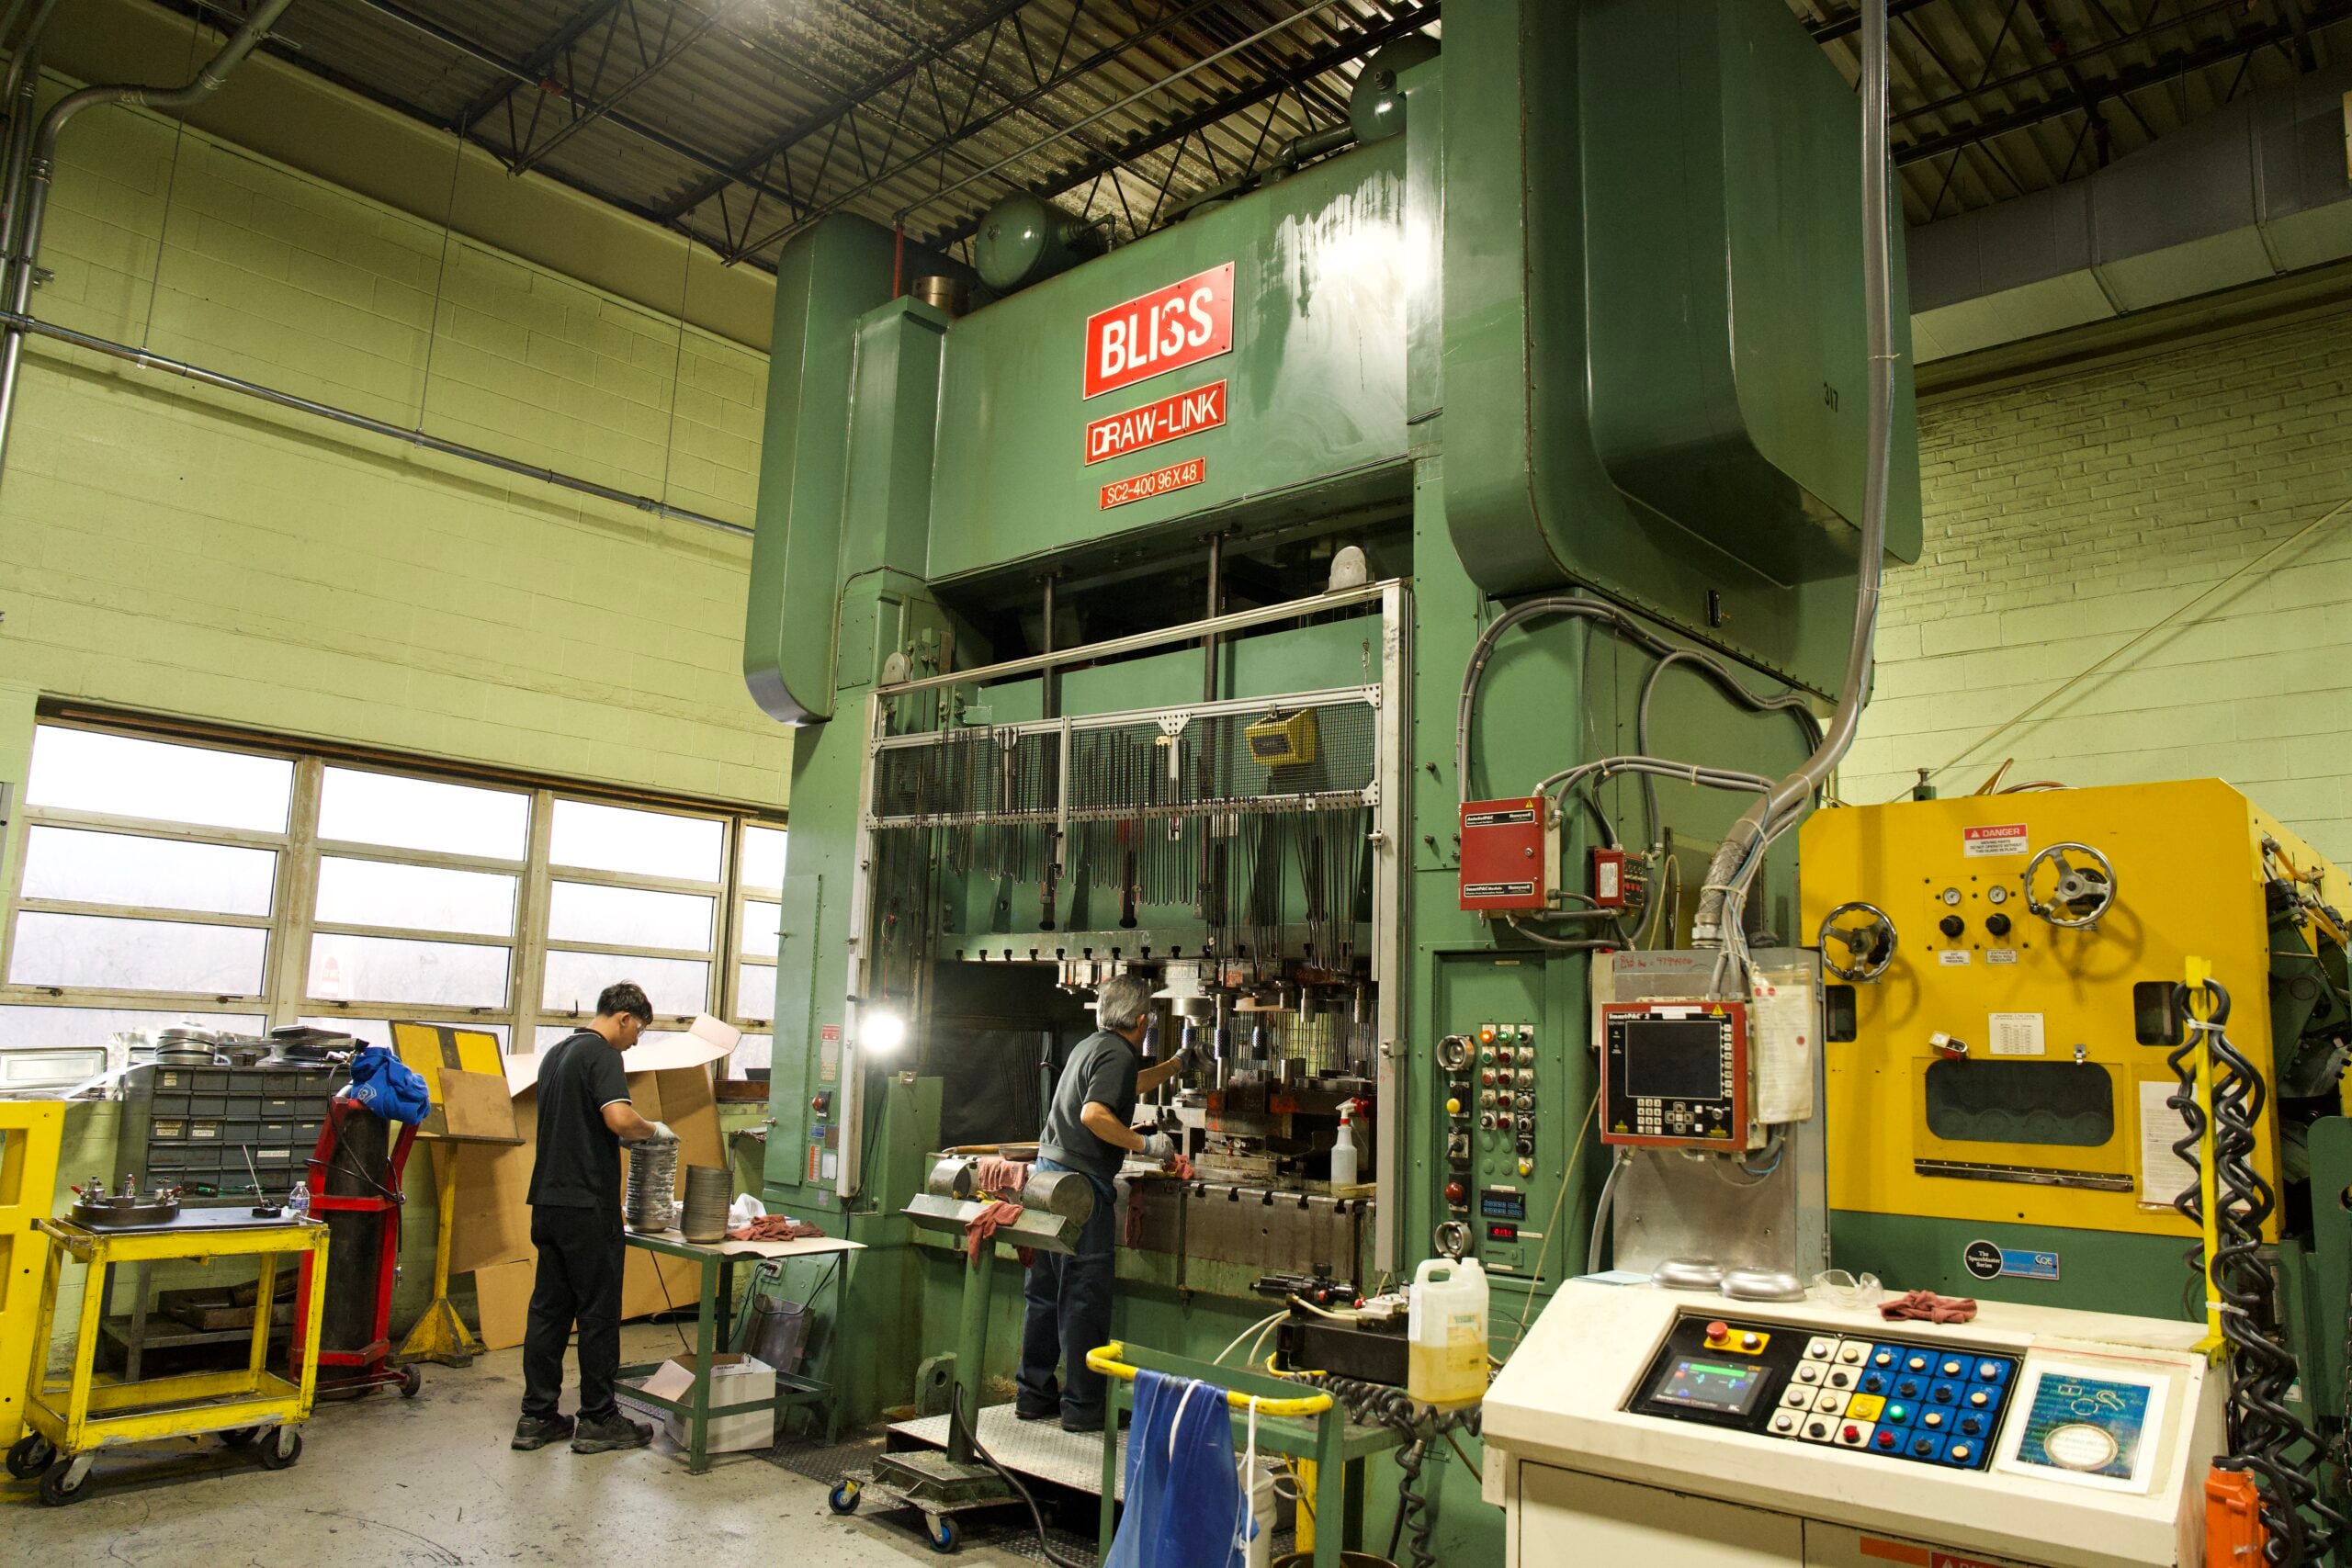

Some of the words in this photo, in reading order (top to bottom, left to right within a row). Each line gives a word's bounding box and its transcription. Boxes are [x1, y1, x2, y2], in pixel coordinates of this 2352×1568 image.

[1101, 287, 1214, 378] BLISS
[1824, 381, 1838, 413] 317
[1092, 390, 1217, 457] DRAW-LINK
[1107, 474, 1155, 504] SC2-400
[1983, 828, 2020, 837] DANGER
[1968, 1256, 2000, 1264] SpaceMaster
